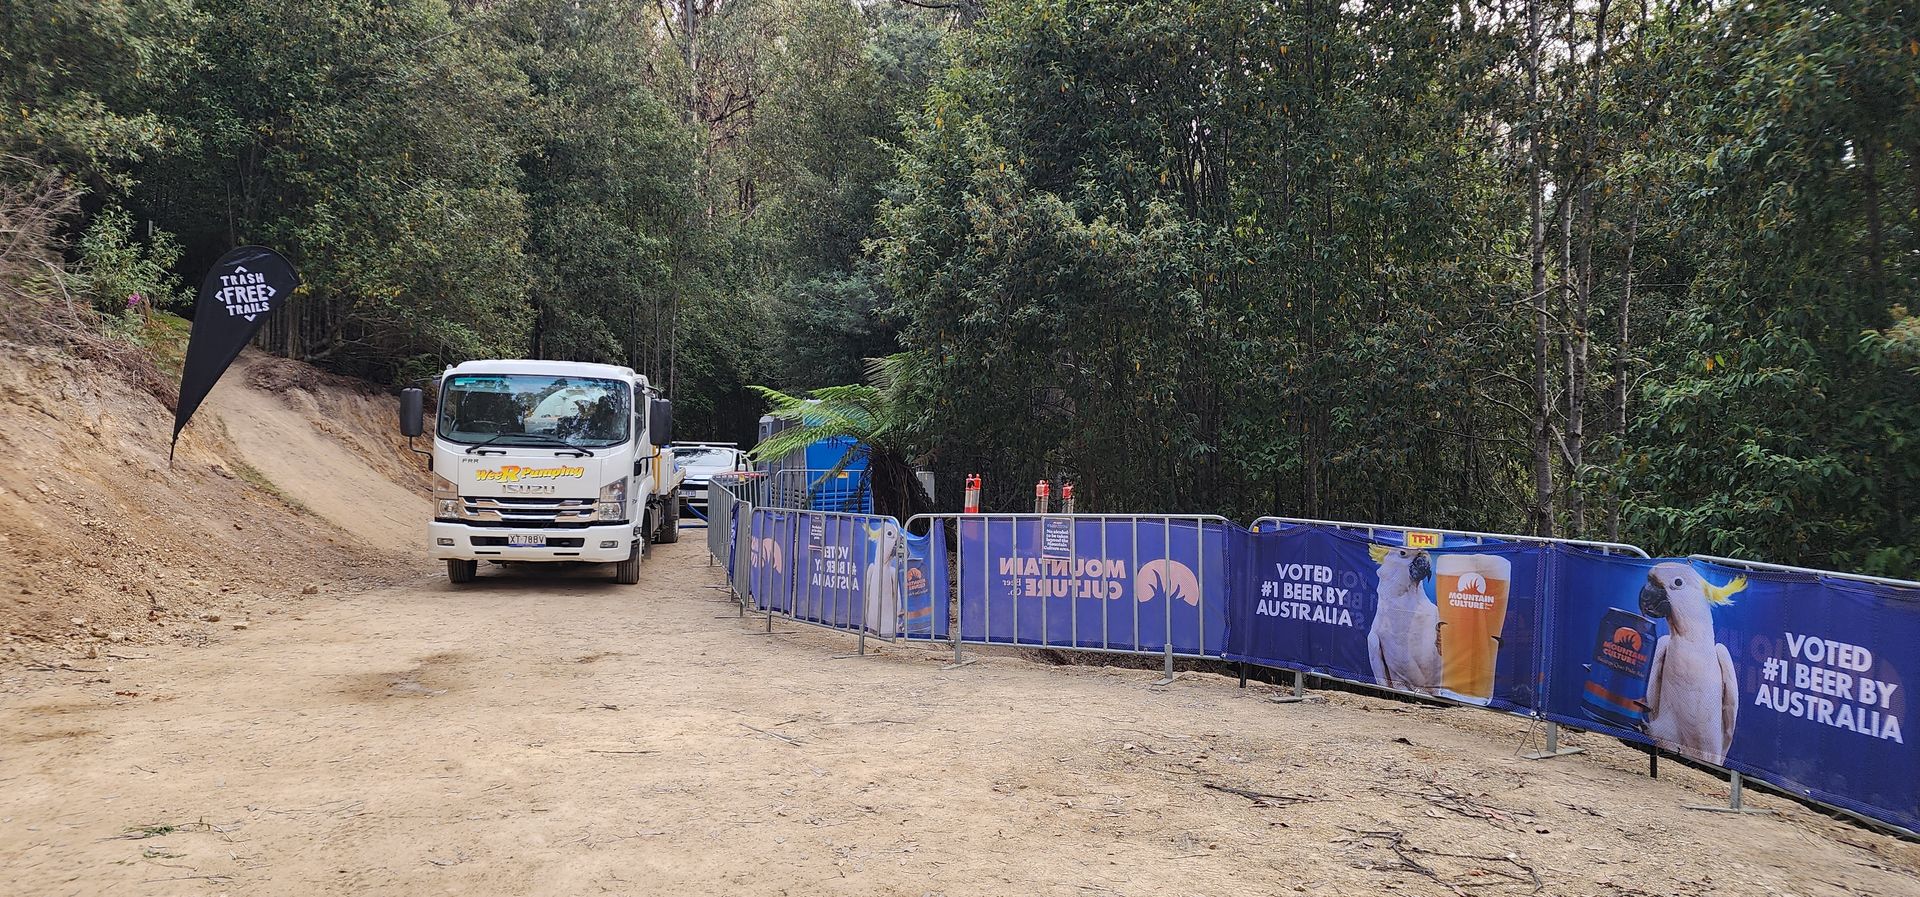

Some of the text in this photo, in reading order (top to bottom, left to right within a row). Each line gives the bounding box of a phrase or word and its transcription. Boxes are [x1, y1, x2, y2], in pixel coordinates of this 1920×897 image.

[220, 273, 264, 286] TRASH
[223, 284, 268, 304] FREE
[226, 302, 270, 316] TRAILS
[521, 465, 585, 480] Pumping
[503, 485, 555, 495] ISUZU
[1412, 535, 1434, 545] TFH
[1276, 563, 1333, 583] VOTED
[1261, 581, 1349, 606] #1 BEER BY
[1448, 591, 1494, 603] MOUNTAIN
[1256, 599, 1353, 627] AUSTRALIA
[1450, 599, 1485, 609] CULTURE
[1603, 641, 1648, 662] MOUNTAIN
[1603, 648, 1637, 665] CULTURE
[1785, 632, 1872, 673] VOTED
[1762, 656, 1898, 709] #1 BEER BY
[1754, 684, 1904, 744] AUSTRALIA
